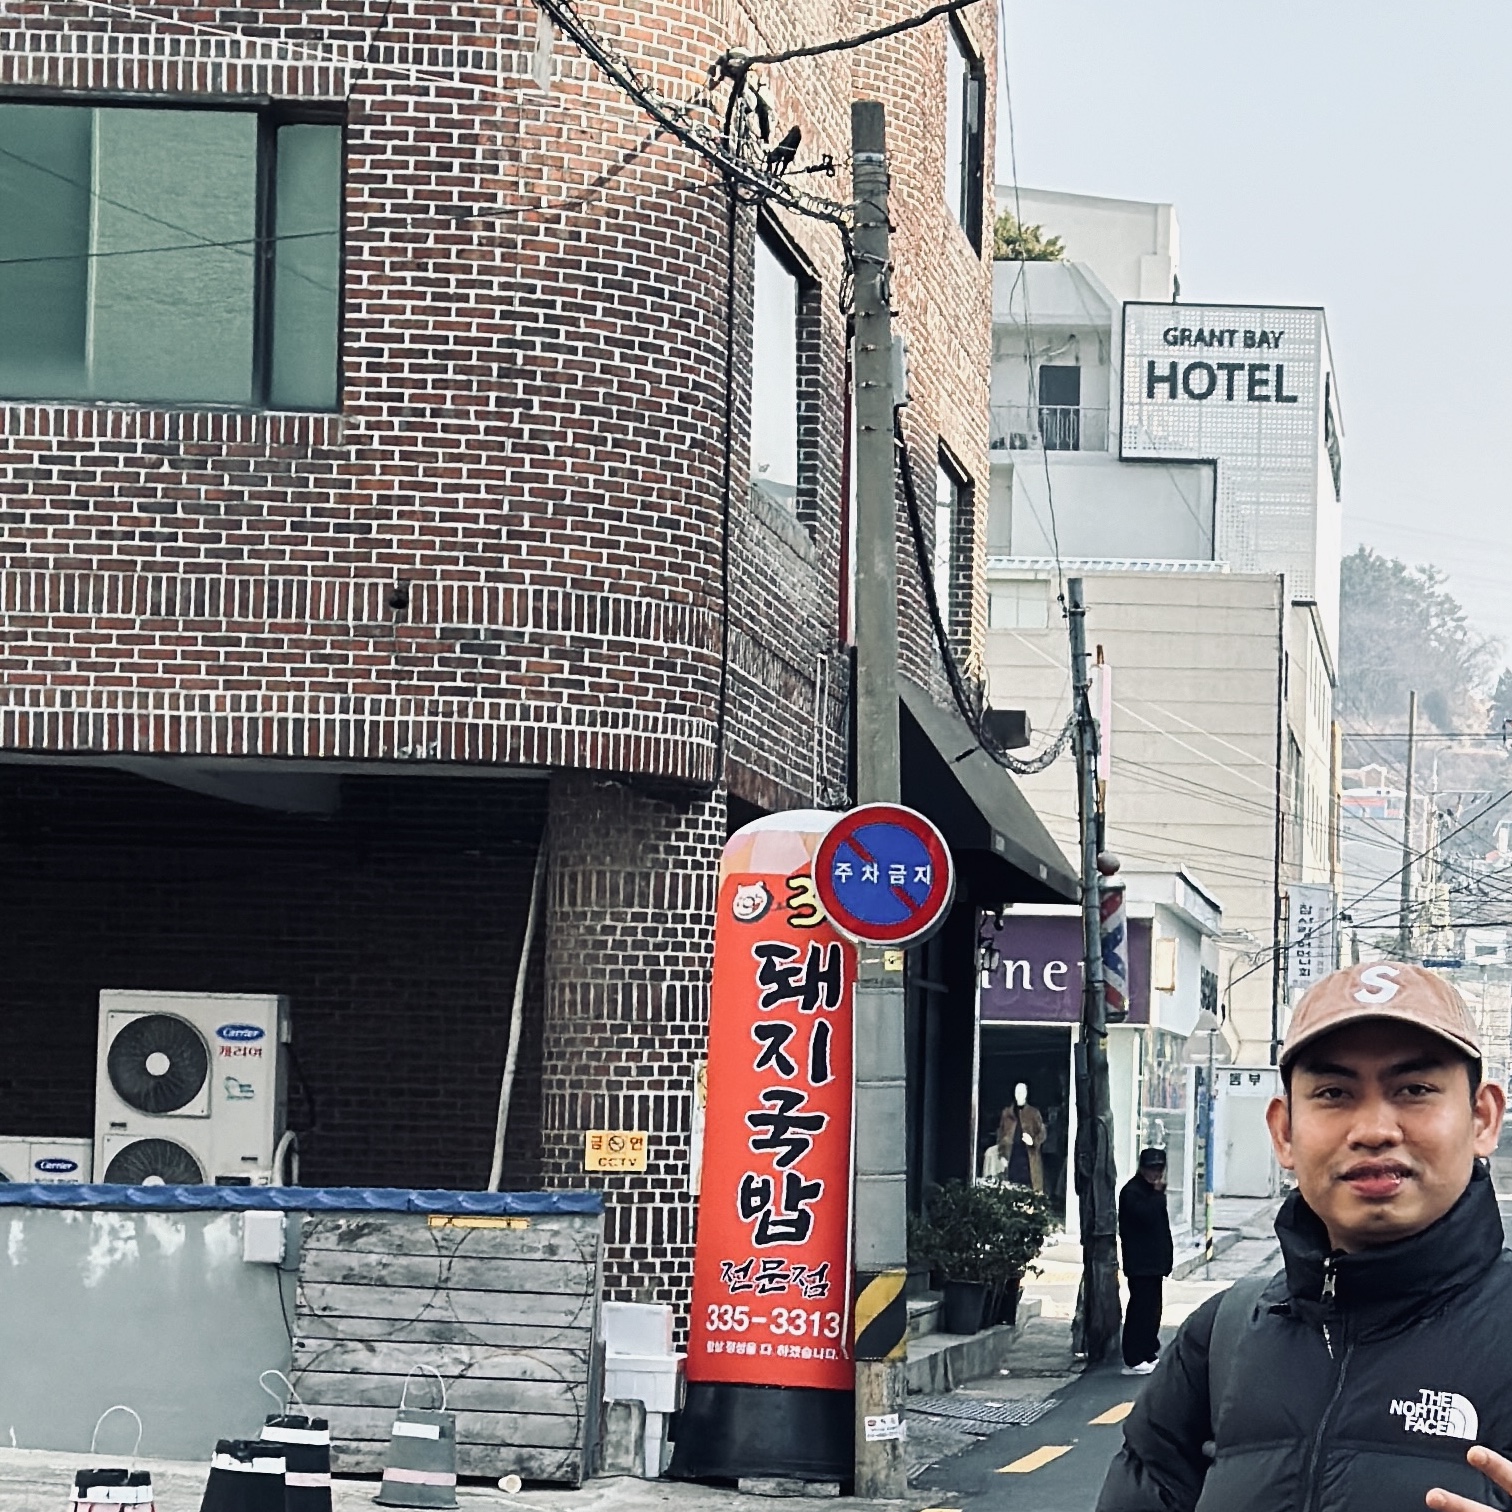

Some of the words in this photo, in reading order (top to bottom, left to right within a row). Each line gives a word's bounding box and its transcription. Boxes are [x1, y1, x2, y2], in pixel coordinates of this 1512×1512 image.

[1163, 327, 1238, 347] GRANT
[1243, 330, 1285, 349] BAY
[1146, 360, 1298, 403] HOTEL
[835, 863, 931, 886] 주차금지
[1352, 965, 1403, 1004] S
[221, 1026, 260, 1040] Carrier
[219, 1045, 262, 1058] 캐리어
[738, 940, 844, 1246] 돼지국밥
[39, 1160, 73, 1172] Carrier
[597, 1157, 637, 1168] CCTV
[720, 1256, 831, 1299] 전문점
[705, 1304, 841, 1339] 335-3313
[1419, 1388, 1452, 1408] THE
[1389, 1399, 1451, 1422] NORTH
[1404, 1416, 1450, 1436] FACE
